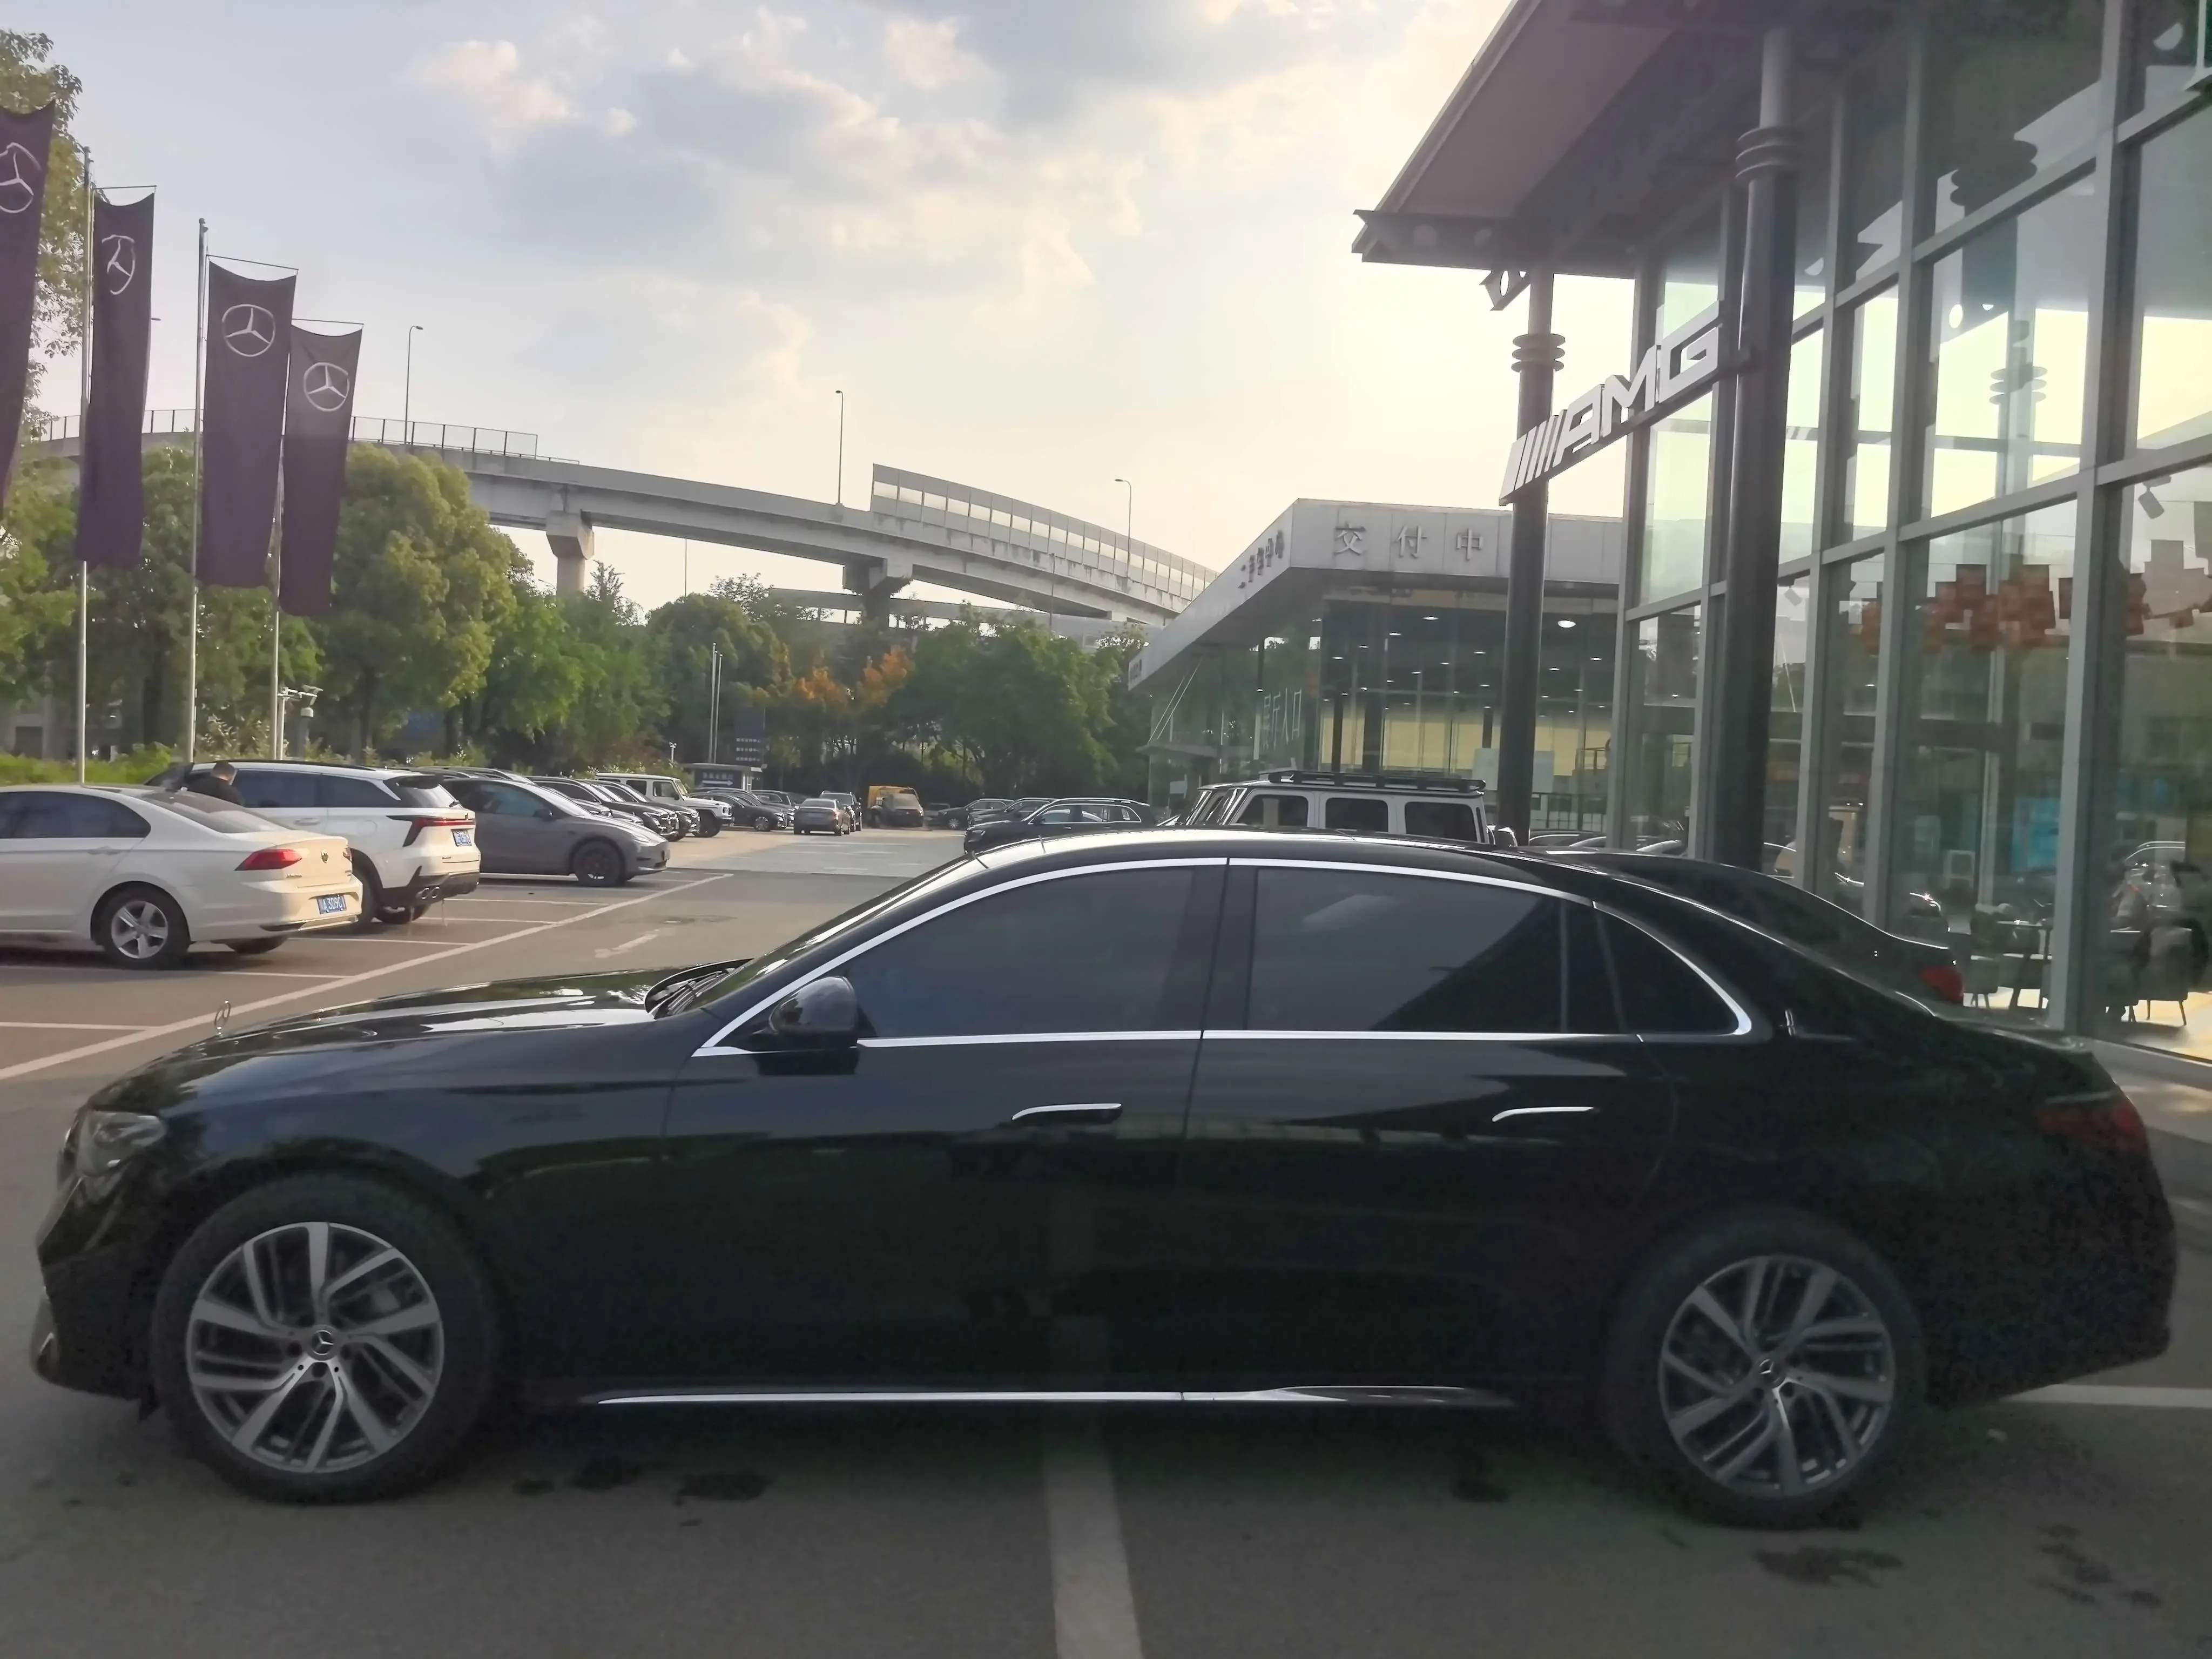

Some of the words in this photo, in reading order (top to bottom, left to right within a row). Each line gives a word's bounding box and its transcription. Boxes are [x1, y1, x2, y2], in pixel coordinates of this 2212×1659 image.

[1553, 300, 1719, 468] AMG
[1334, 521, 1484, 561] 交付中
